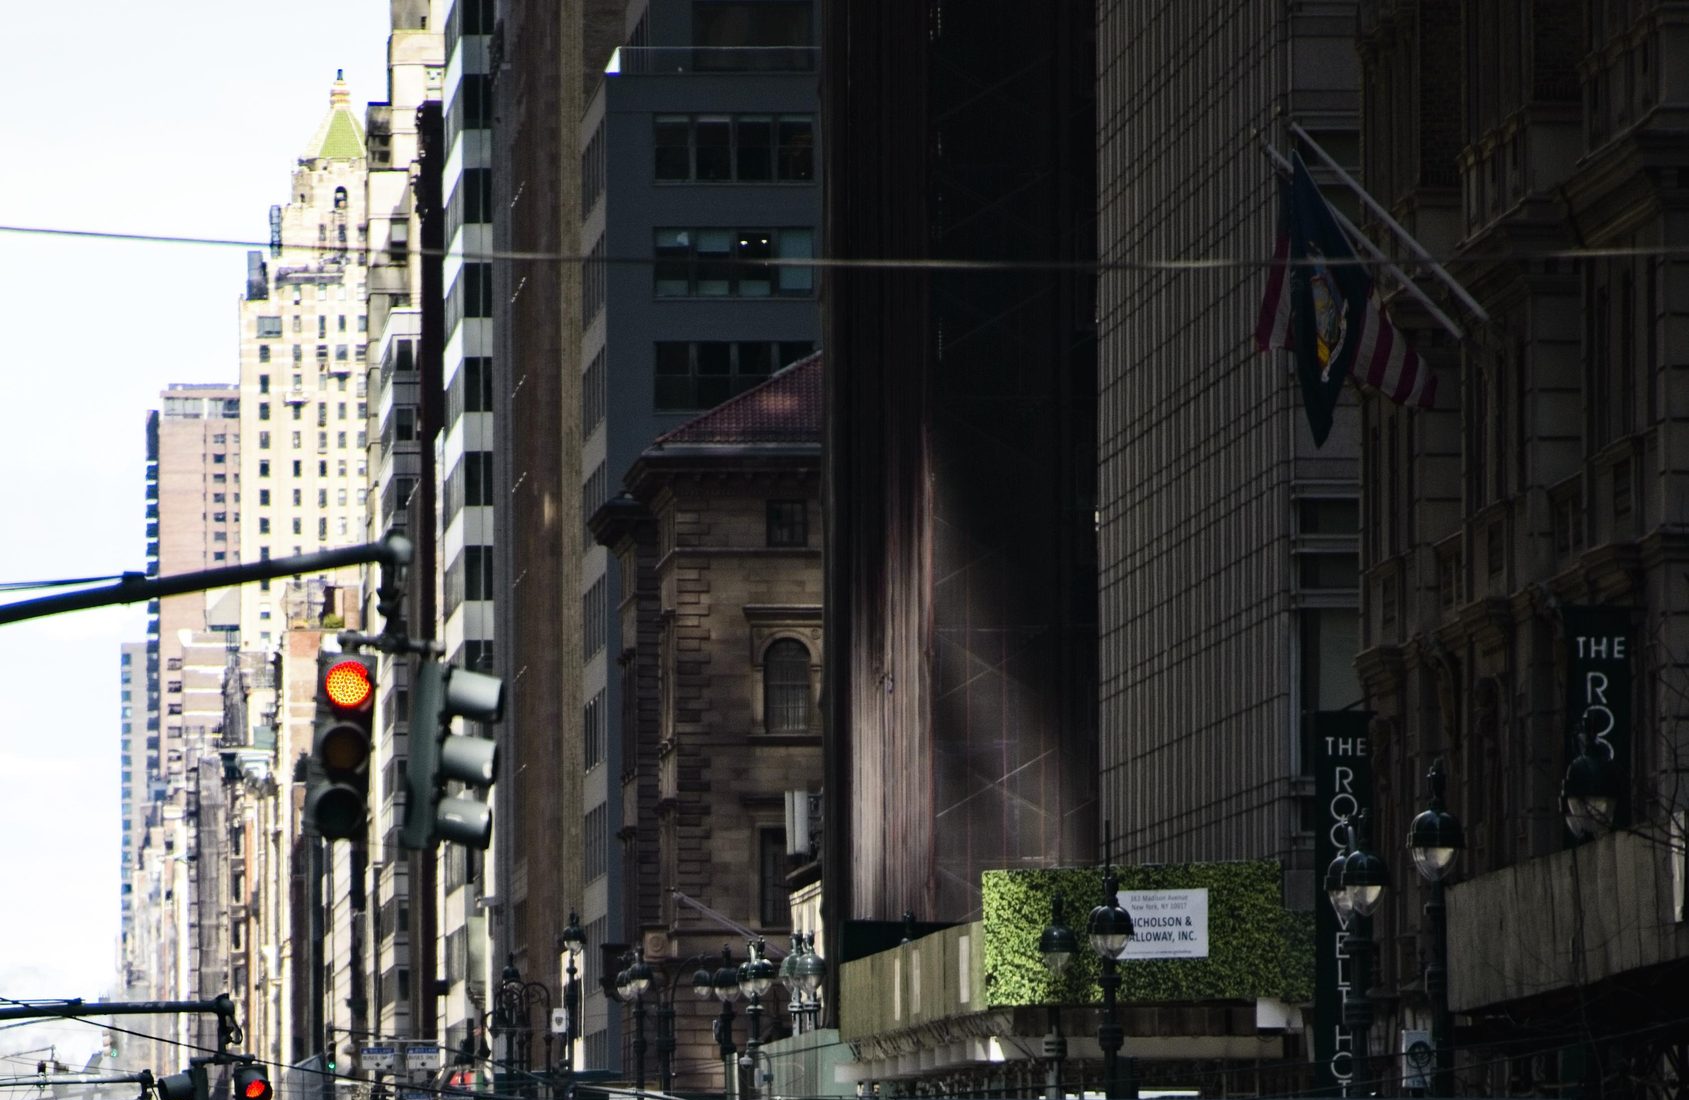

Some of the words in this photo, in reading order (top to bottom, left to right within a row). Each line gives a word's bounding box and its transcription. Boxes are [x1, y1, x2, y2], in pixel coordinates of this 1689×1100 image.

[1576, 637, 1626, 659] THE
[1325, 736, 1368, 757] THE
[1185, 915, 1193, 926] &
[1178, 930, 1197, 942] INC.
